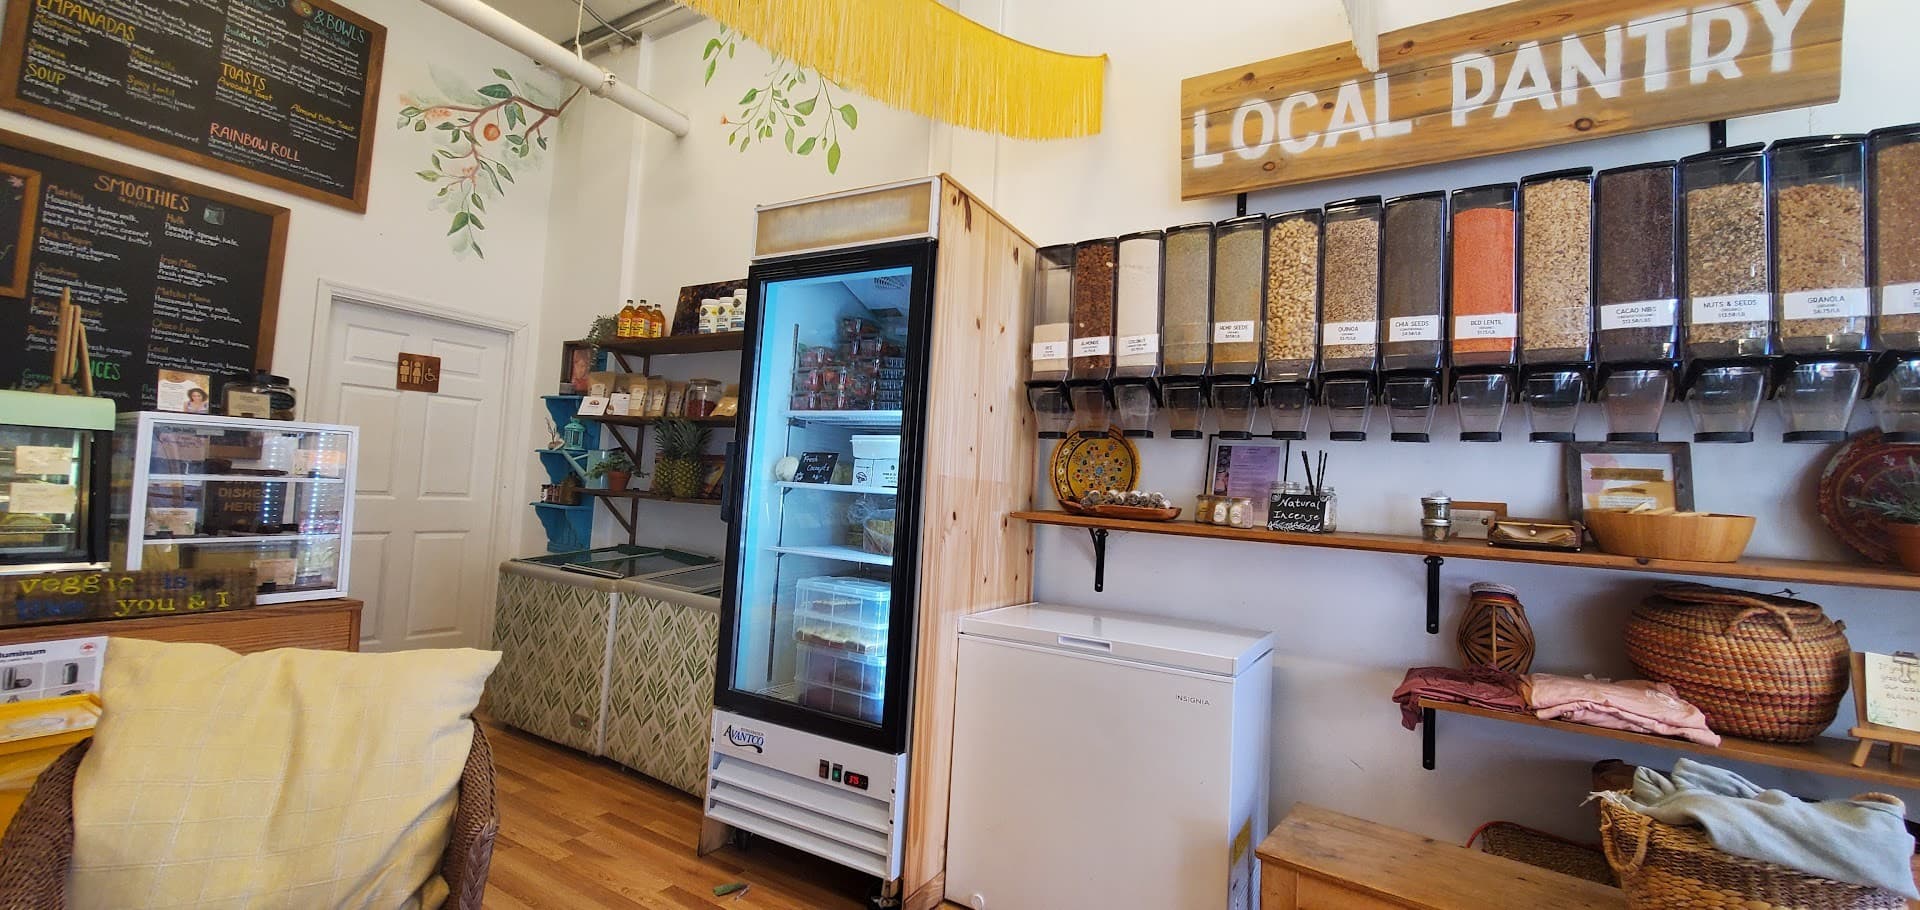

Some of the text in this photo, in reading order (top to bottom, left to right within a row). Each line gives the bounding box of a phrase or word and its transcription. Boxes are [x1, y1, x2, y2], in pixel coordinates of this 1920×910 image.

[37, 0, 136, 41] EMPANADAS
[313, 9, 365, 44] & BOWLS
[252, 35, 269, 48] Bowl
[26, 63, 66, 85] SOUP
[220, 62, 267, 91] TOASTS
[1193, 0, 1809, 169] LOCAL PANTRY
[217, 76, 273, 102] Avocado Toast
[210, 122, 268, 152] RAINBOW
[270, 142, 301, 162] ROLL
[95, 175, 190, 213] SMOOTHIES
[1703, 301, 1724, 309] NUTS
[1734, 299, 1758, 307] SEEDS
[1807, 295, 1846, 304] GRANOLA
[1616, 307, 1642, 315] CACAO
[803, 455, 818, 463] Fresh
[224, 501, 261, 512] HERE
[1277, 496, 1321, 510] Natural
[1272, 510, 1321, 523] Incense
[114, 597, 176, 617] you
[188, 593, 206, 610] &
[216, 591, 230, 608] I
[1176, 694, 1210, 706] INSIGNIA
[723, 724, 764, 747] AVANTCO
